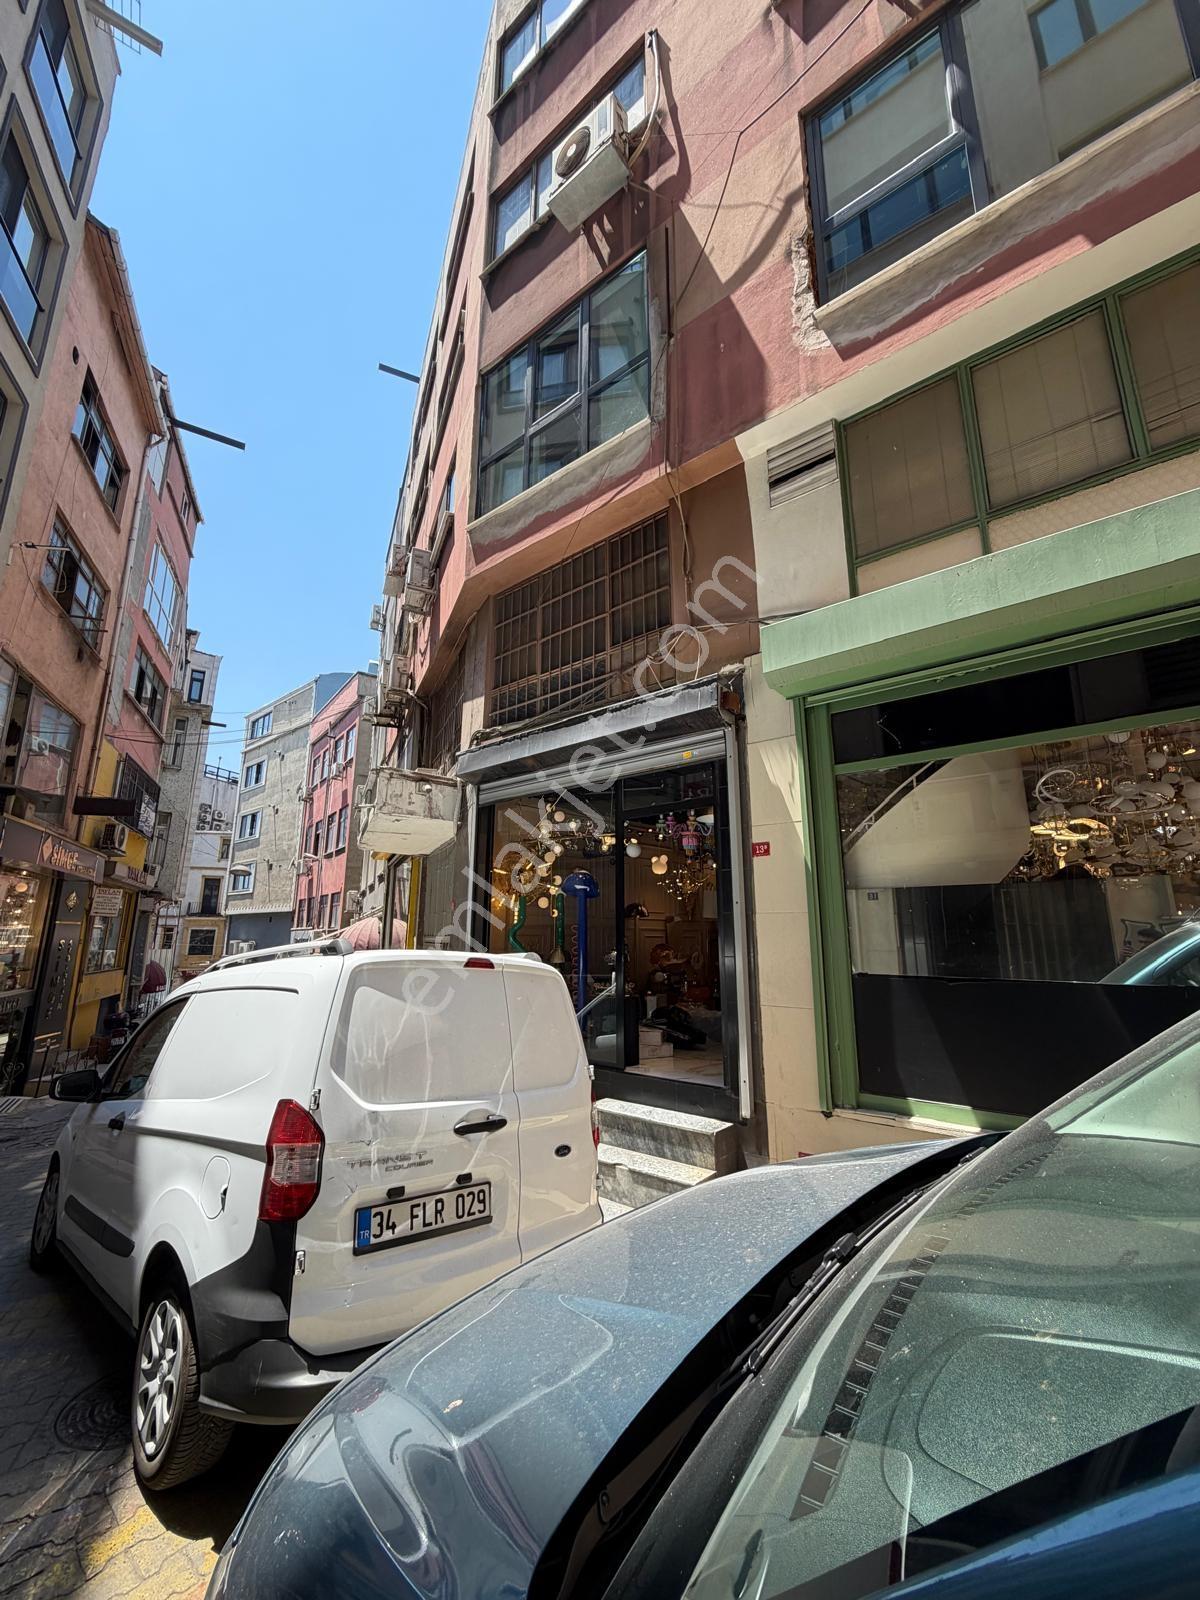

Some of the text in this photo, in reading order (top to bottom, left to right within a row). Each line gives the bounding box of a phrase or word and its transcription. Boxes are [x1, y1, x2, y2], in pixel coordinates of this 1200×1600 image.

[347, 1151, 427, 1169] TRANST
[360, 1188, 487, 1240] TR 34 FLR 029
